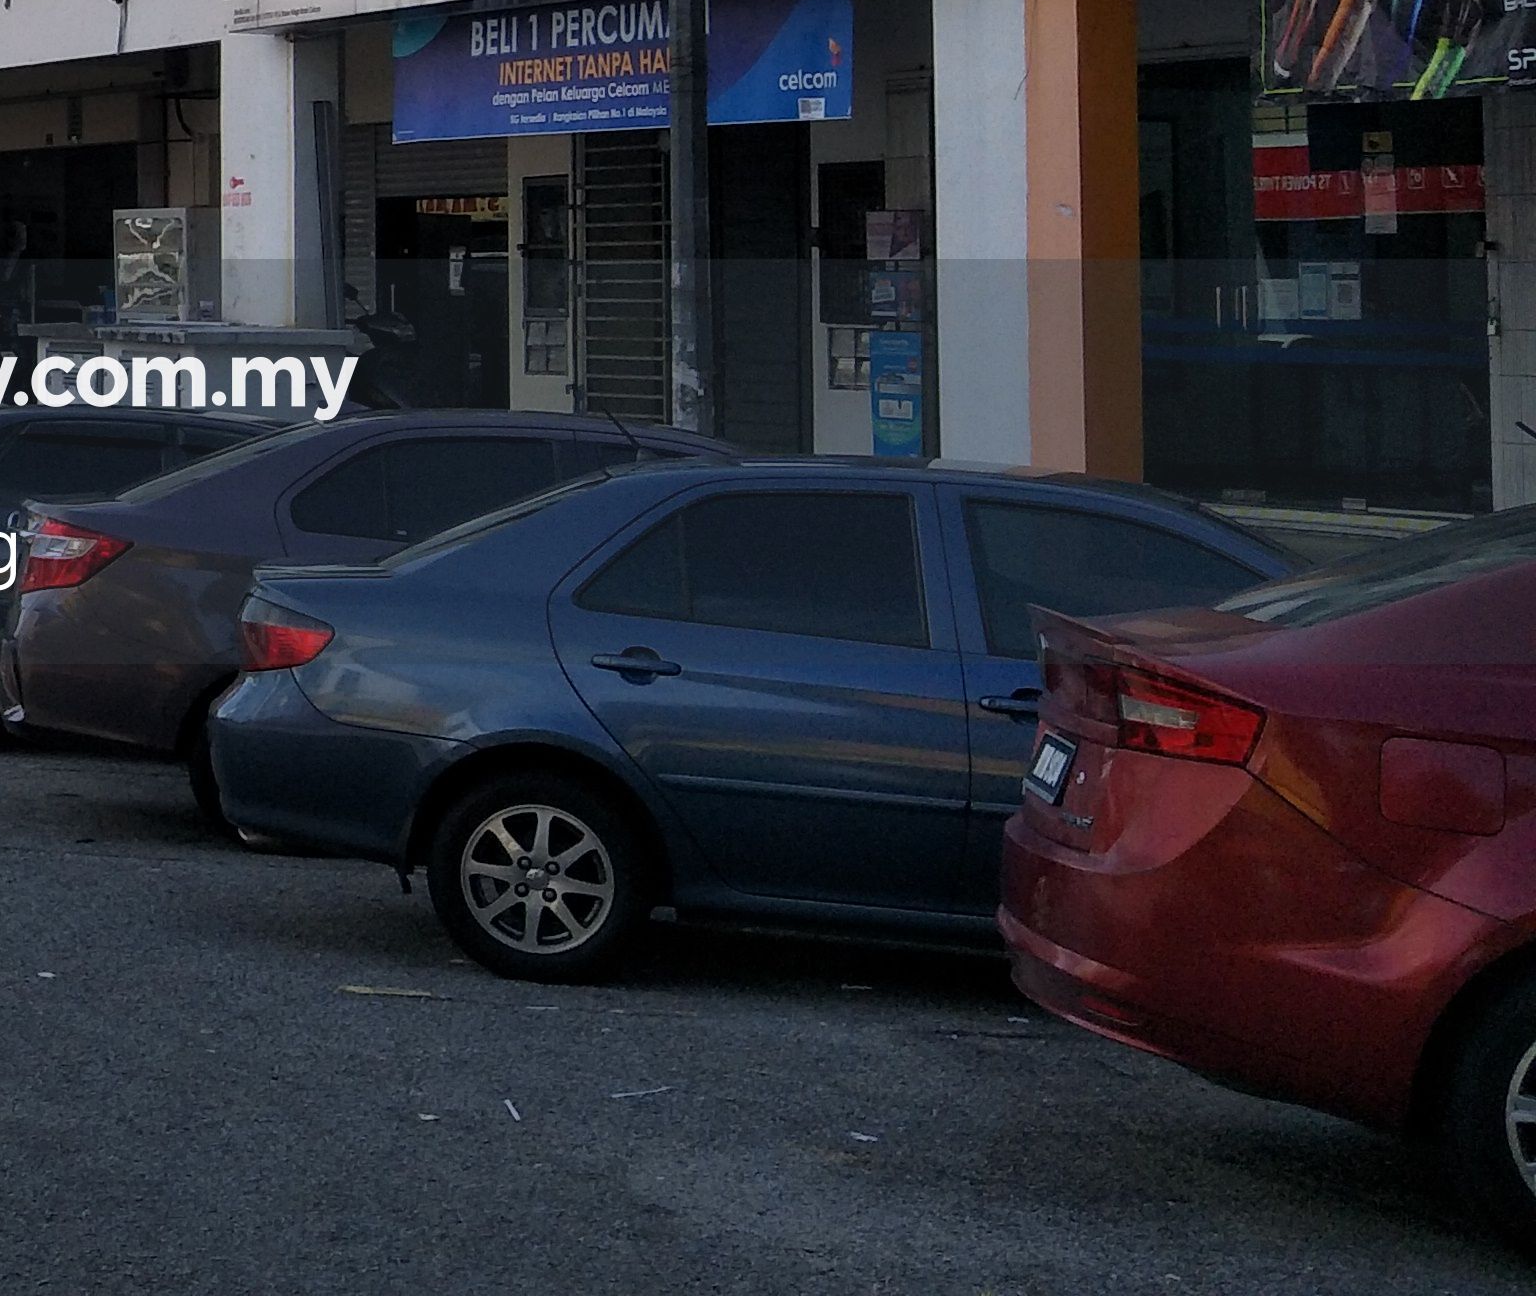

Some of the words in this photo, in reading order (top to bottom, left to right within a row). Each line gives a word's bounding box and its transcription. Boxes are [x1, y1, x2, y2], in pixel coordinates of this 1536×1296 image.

[471, 16, 517, 56] BELI
[529, 14, 538, 50] 1
[552, 0, 671, 49] PERCUM
[499, 55, 573, 86] INTERNET
[577, 52, 633, 80] TANPA
[639, 48, 671, 74] HA
[779, 69, 837, 90] celcom
[492, 92, 529, 108] dengan
[532, 89, 558, 103] Pelan
[561, 85, 606, 102] Keluarga
[608, 82, 649, 97] Celcom
[652, 79, 670, 94] ME
